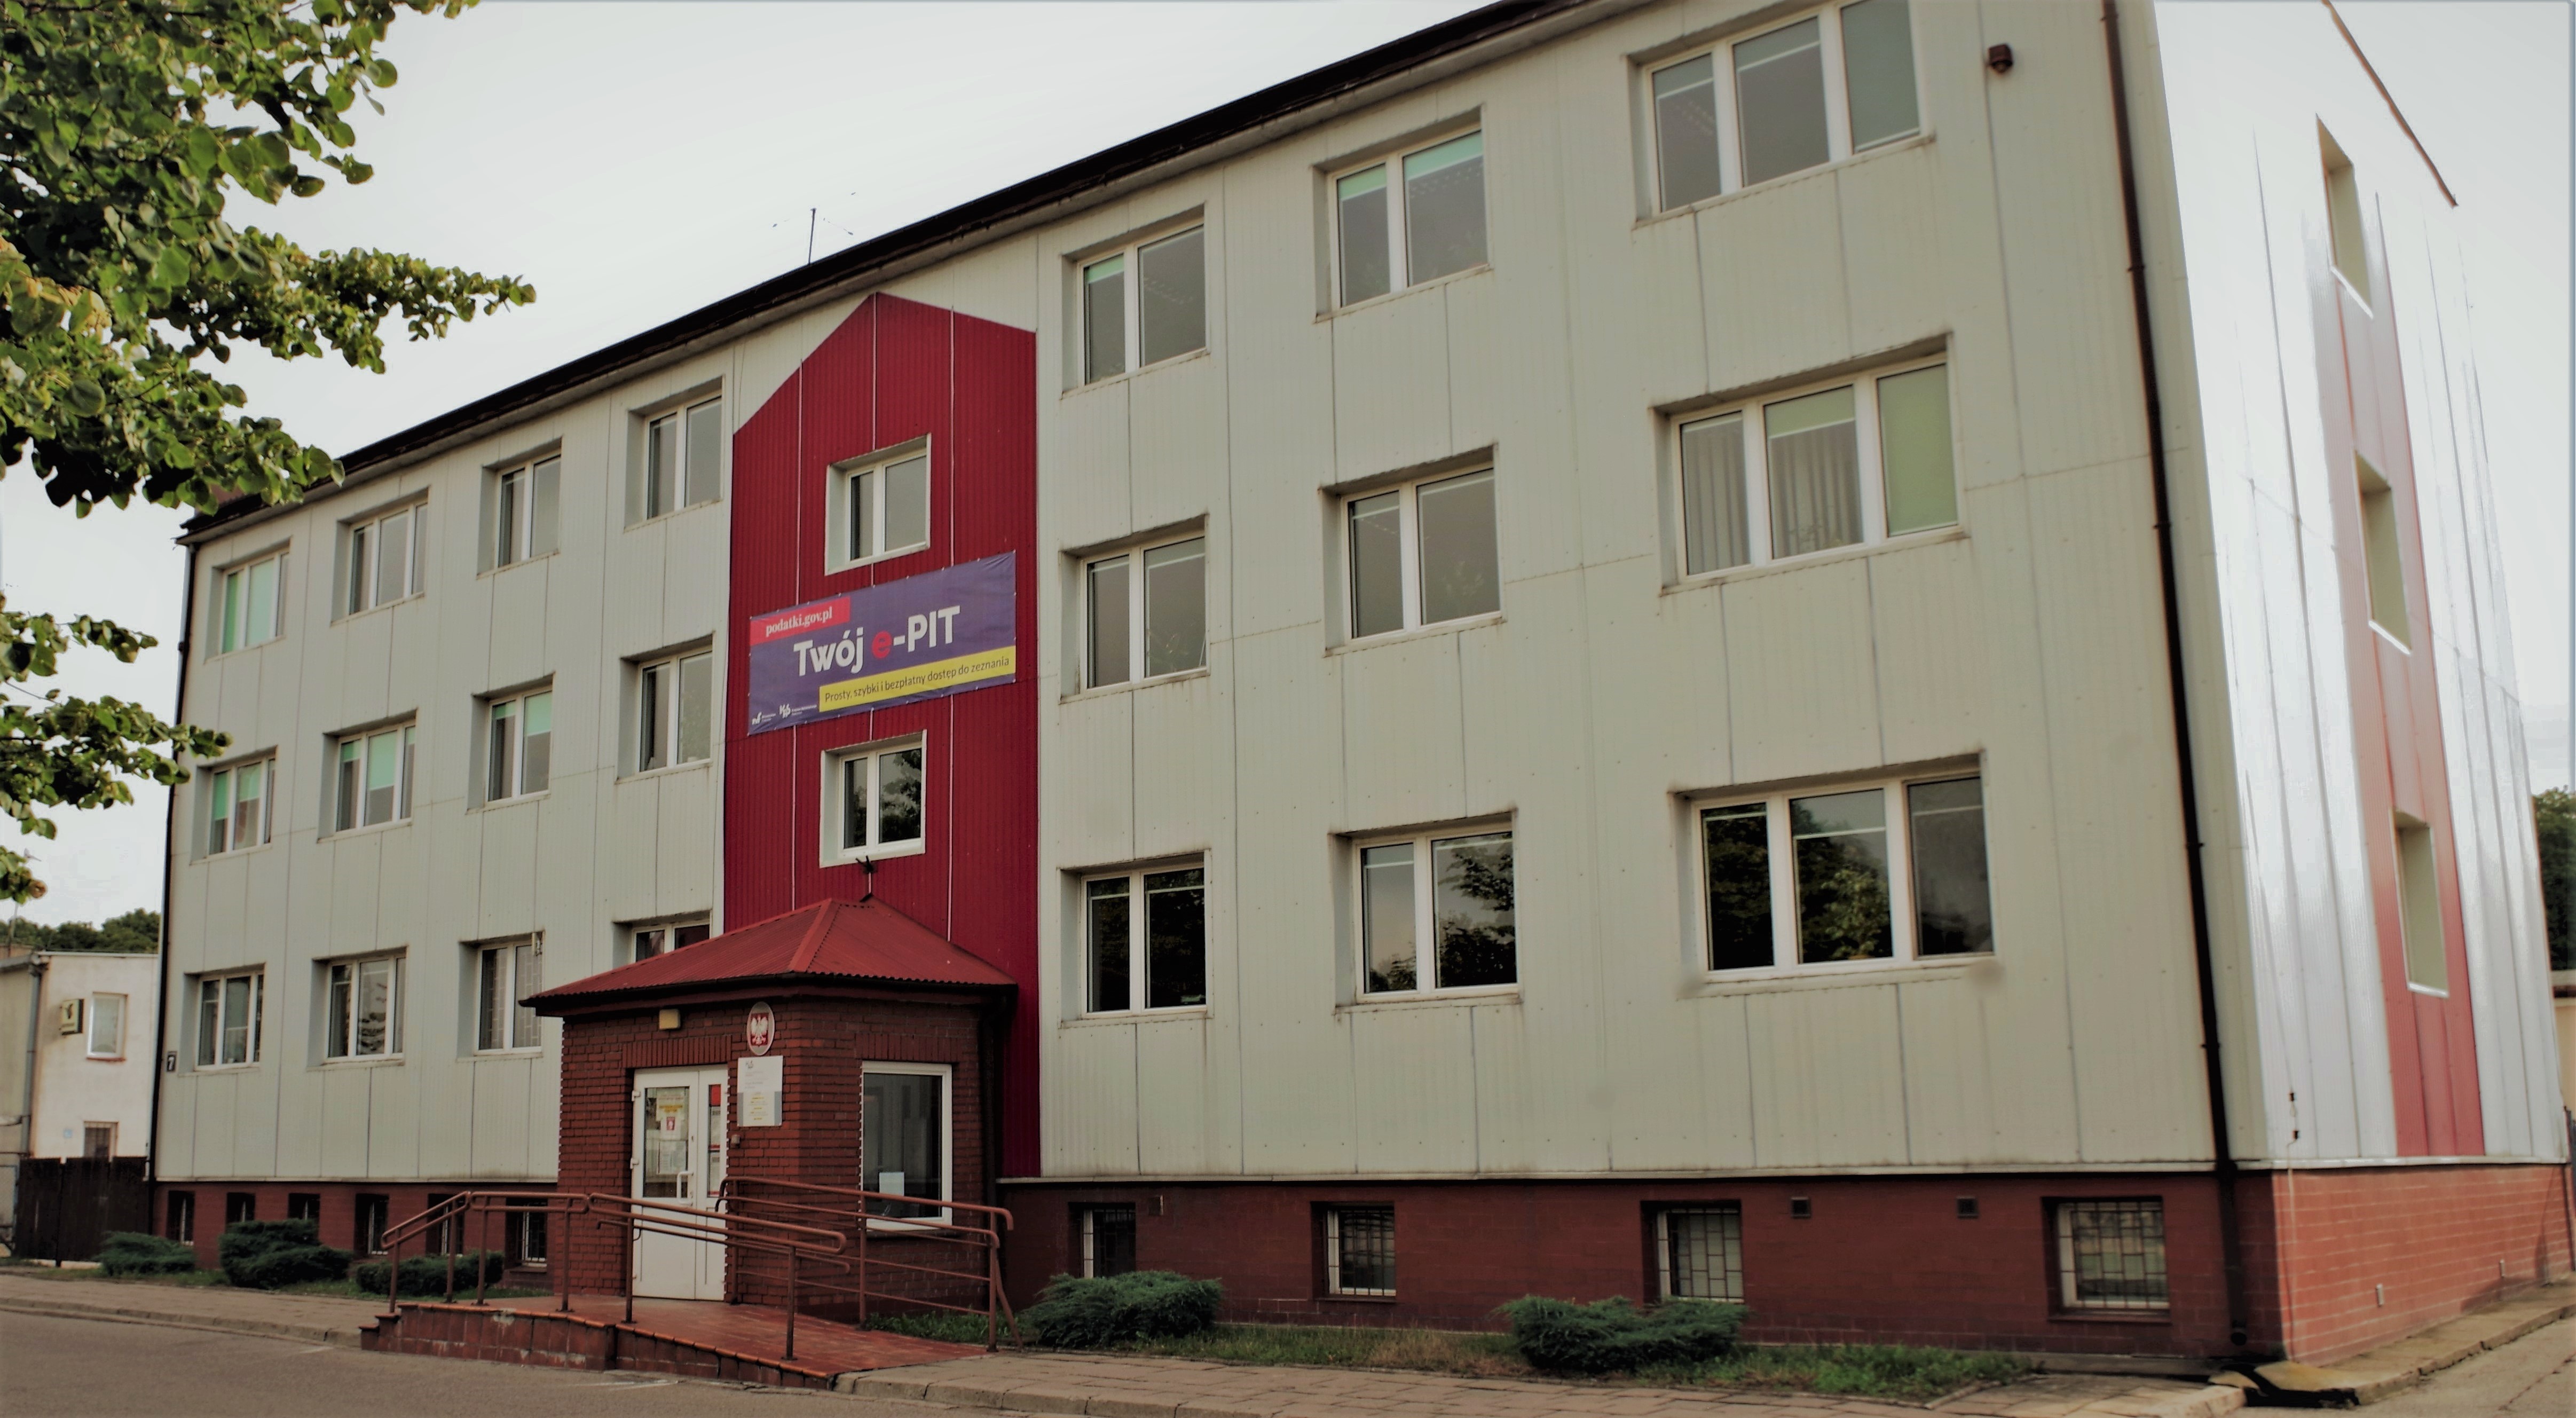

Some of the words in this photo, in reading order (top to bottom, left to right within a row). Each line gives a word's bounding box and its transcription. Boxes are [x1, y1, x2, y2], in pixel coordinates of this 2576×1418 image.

[766, 606, 832, 637] podatki.gov.pl
[793, 627, 864, 676] Twój
[872, 605, 960, 659] e-PIT
[825, 689, 853, 703] Prosty,
[854, 682, 879, 697] szybki
[885, 675, 926, 691] bezpłatny
[927, 670, 956, 682] dostęp
[958, 664, 970, 675] do
[971, 656, 1009, 673] zeznania
[169, 1056, 175, 1070] 7
